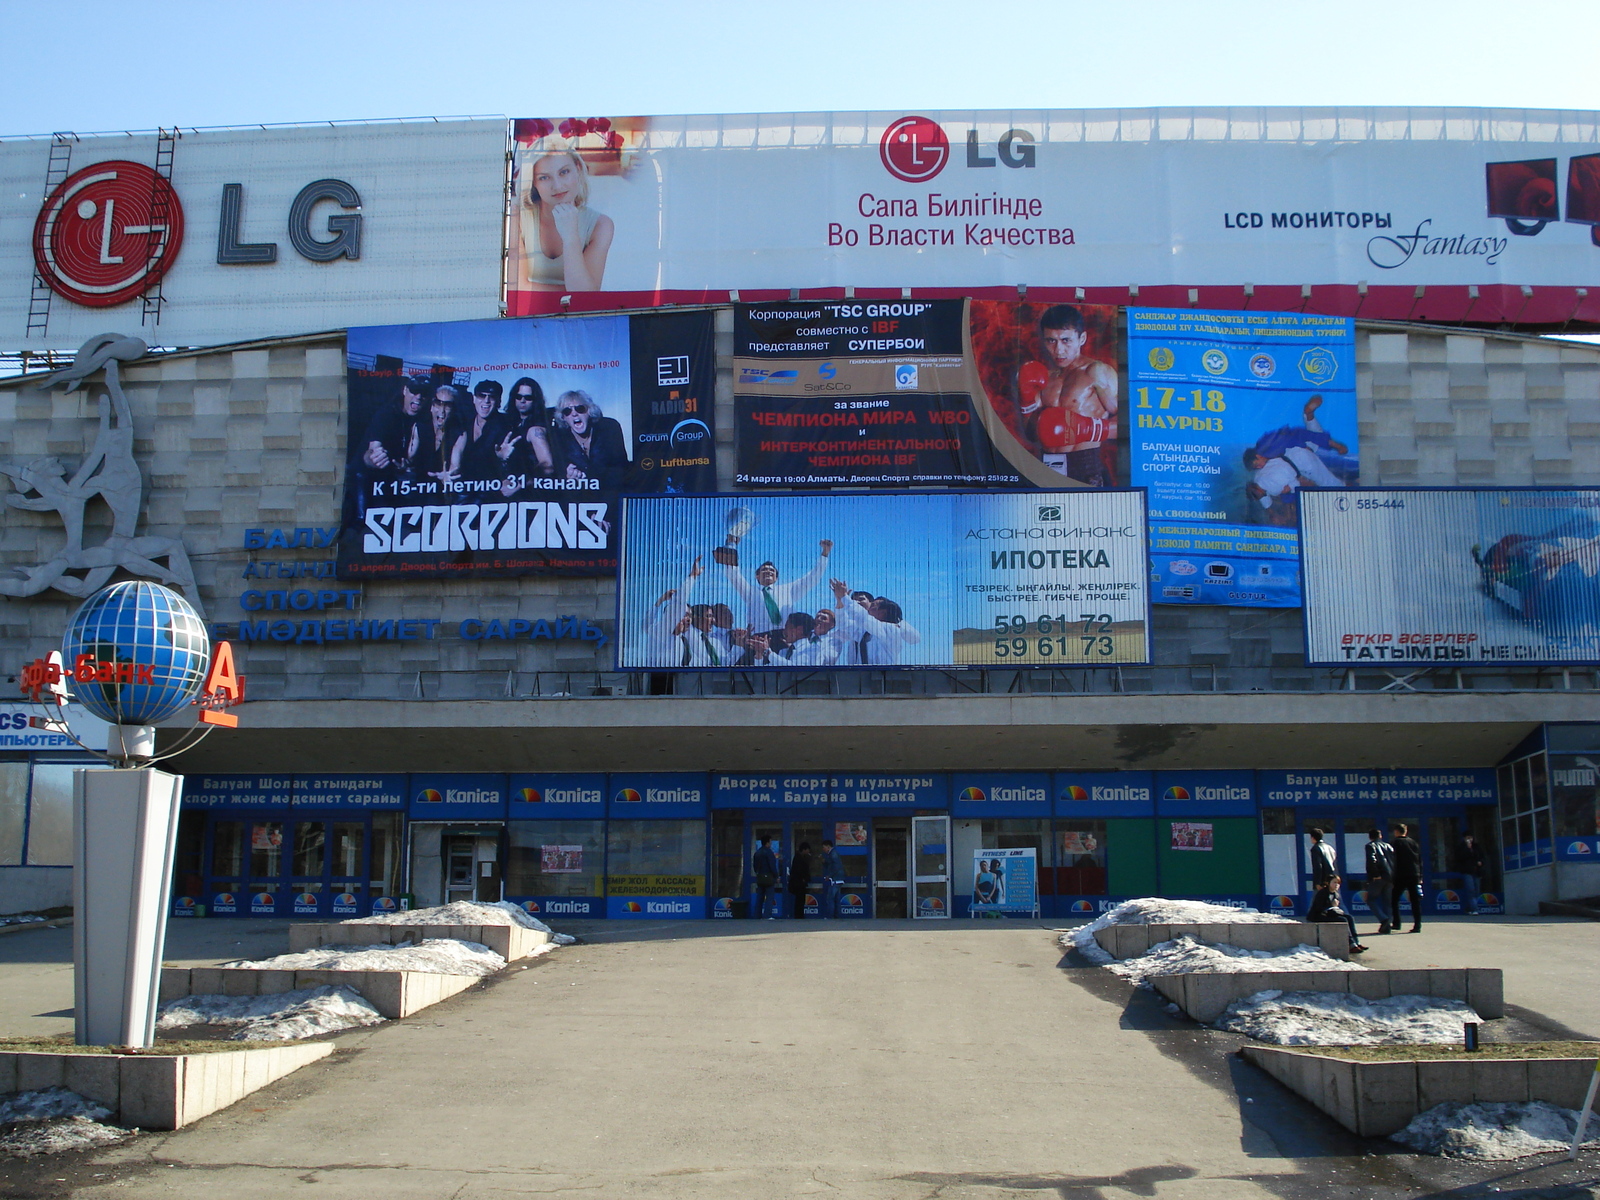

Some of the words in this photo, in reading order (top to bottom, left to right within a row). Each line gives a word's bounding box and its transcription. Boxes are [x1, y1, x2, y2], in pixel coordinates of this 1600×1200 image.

[967, 128, 1035, 169] LG
[858, 193, 918, 217] Сапа
[928, 192, 1042, 219] Билігінде
[217, 178, 363, 264] LG
[1224, 212, 1264, 229] LCD
[1272, 212, 1392, 229] МОНИТОРЫ
[828, 223, 859, 246] Во
[869, 224, 954, 246] Власти
[965, 223, 1075, 246] Качества
[1366, 218, 1508, 269] Fantasy
[749, 309, 821, 321] Корпорация
[824, 305, 863, 318] "TSC
[870, 303, 932, 317] GROUP"
[1180, 313, 1245, 323] ДЖАНДОСОВТЫ
[1247, 316, 1268, 324] ЕСКЕ
[796, 325, 859, 336] совместно
[862, 326, 869, 335] с
[872, 321, 899, 333] IBF
[749, 341, 830, 353] представляет
[848, 338, 925, 351] СУПЕРБОИ
[484, 363, 510, 372] Спорт
[512, 361, 549, 370] Сарайы.
[551, 361, 596, 372] Басталуы
[598, 360, 620, 369] 19:00
[804, 382, 852, 392] Sat&Co
[834, 401, 848, 409] за
[849, 399, 890, 410] звание
[1136, 387, 1226, 413] 17-18
[752, 411, 859, 427] ЧЕМПИОНА
[863, 410, 917, 426] МИРА
[928, 410, 970, 424] WBO
[1138, 414, 1224, 432] НАУРЫЗ
[639, 433, 669, 443] Corum
[677, 431, 704, 441] Group
[859, 428, 866, 436] и
[761, 438, 961, 452] ИНТЕРКОНТИНЕНТАЛЬНОГО
[1142, 442, 1182, 452] БАЛУАН
[1184, 444, 1220, 455] ШОЛАҚ
[660, 457, 710, 467] Lufthansa
[808, 455, 890, 467] ЧЕМПИОНА
[894, 453, 917, 465] IBF
[1152, 453, 1210, 464] АТЫНДАҒЫ
[1142, 463, 1176, 473] СПОРТ
[1178, 463, 1221, 475] САРАЙЫ
[373, 481, 385, 496] К
[389, 480, 437, 495] 15-ти
[442, 478, 501, 495] летию
[506, 474, 527, 491] 31
[533, 477, 600, 491] канала
[736, 474, 749, 482] 24
[751, 476, 782, 484] марта
[807, 475, 849, 483] Алматы.
[882, 474, 910, 482] Спорта
[1357, 499, 1405, 510] 585-444
[1165, 510, 1226, 520] СВОБОДНЫЙ
[363, 502, 608, 554] SCORPIONS
[1158, 526, 1240, 537] МЕЖДУНАРОДНЫЙ
[1156, 539, 1190, 548] ДЗЮДО
[1194, 540, 1233, 550] ПАМЯТИ
[1236, 542, 1287, 554] САНДЖАРА
[348, 564, 359, 572] 13
[361, 564, 397, 573] апреля.
[400, 562, 437, 572] Дворец
[439, 561, 474, 571] Спорта
[549, 559, 585, 567] Начало
[991, 549, 1110, 570] ИПОТЕКА
[966, 584, 1013, 593] ТЕЗІРЕК.
[1078, 583, 1141, 592] ЖЕҢІЛІРЕК.
[240, 588, 361, 611] СПОРТ
[987, 594, 1042, 602] БЫСТРЕЕ.
[1045, 594, 1083, 602] ГИБЧЕ.
[1086, 593, 1130, 602] ПРОЩЕ.
[995, 615, 1027, 635] 59
[1037, 614, 1066, 634] 61
[1080, 613, 1113, 633] 72
[239, 618, 440, 645] МӘДЕНИЕТ
[994, 636, 1027, 657] 59
[1037, 636, 1067, 656] 61
[1080, 635, 1114, 656] 73
[1341, 633, 1392, 645] ӨТКІР
[1398, 633, 1479, 644] ӘСЕРЛЕР
[1341, 645, 1472, 661] ТАТЫМДЫ
[203, 778, 251, 790] Балуан
[259, 778, 308, 790] Шолақ
[314, 778, 383, 790] атындағы
[719, 776, 777, 789] Дворец
[783, 777, 838, 789] спорта
[844, 778, 853, 788] и
[859, 778, 933, 789] культуры
[1286, 774, 1338, 787] Балуан
[1345, 774, 1398, 787] Шолақ
[1403, 773, 1475, 786] атындағы
[1553, 769, 1596, 786] PUMA
[185, 794, 225, 805] спорт
[231, 794, 266, 804] және
[271, 793, 341, 805] мәдениет
[347, 792, 401, 805] сарайы
[446, 788, 500, 803] Konica
[544, 788, 601, 803] Konica
[646, 788, 700, 803] Konica
[750, 793, 777, 803] им.
[784, 791, 847, 804] Балуана
[855, 791, 916, 803] Шолака
[990, 786, 1046, 802] Konica
[1091, 785, 1150, 801] Konica
[1195, 785, 1250, 800] Konica
[1268, 789, 1311, 801] спорт
[1317, 789, 1354, 800] және
[1359, 788, 1433, 801] мәдениет
[1438, 787, 1492, 799] сарайы
[629, 877, 648, 885] ЖОЛ
[610, 886, 697, 895] ЖЕЛЕЗНОДОРОЖНАЯ
[545, 900, 590, 914] Konica
[646, 900, 691, 913] Konica
